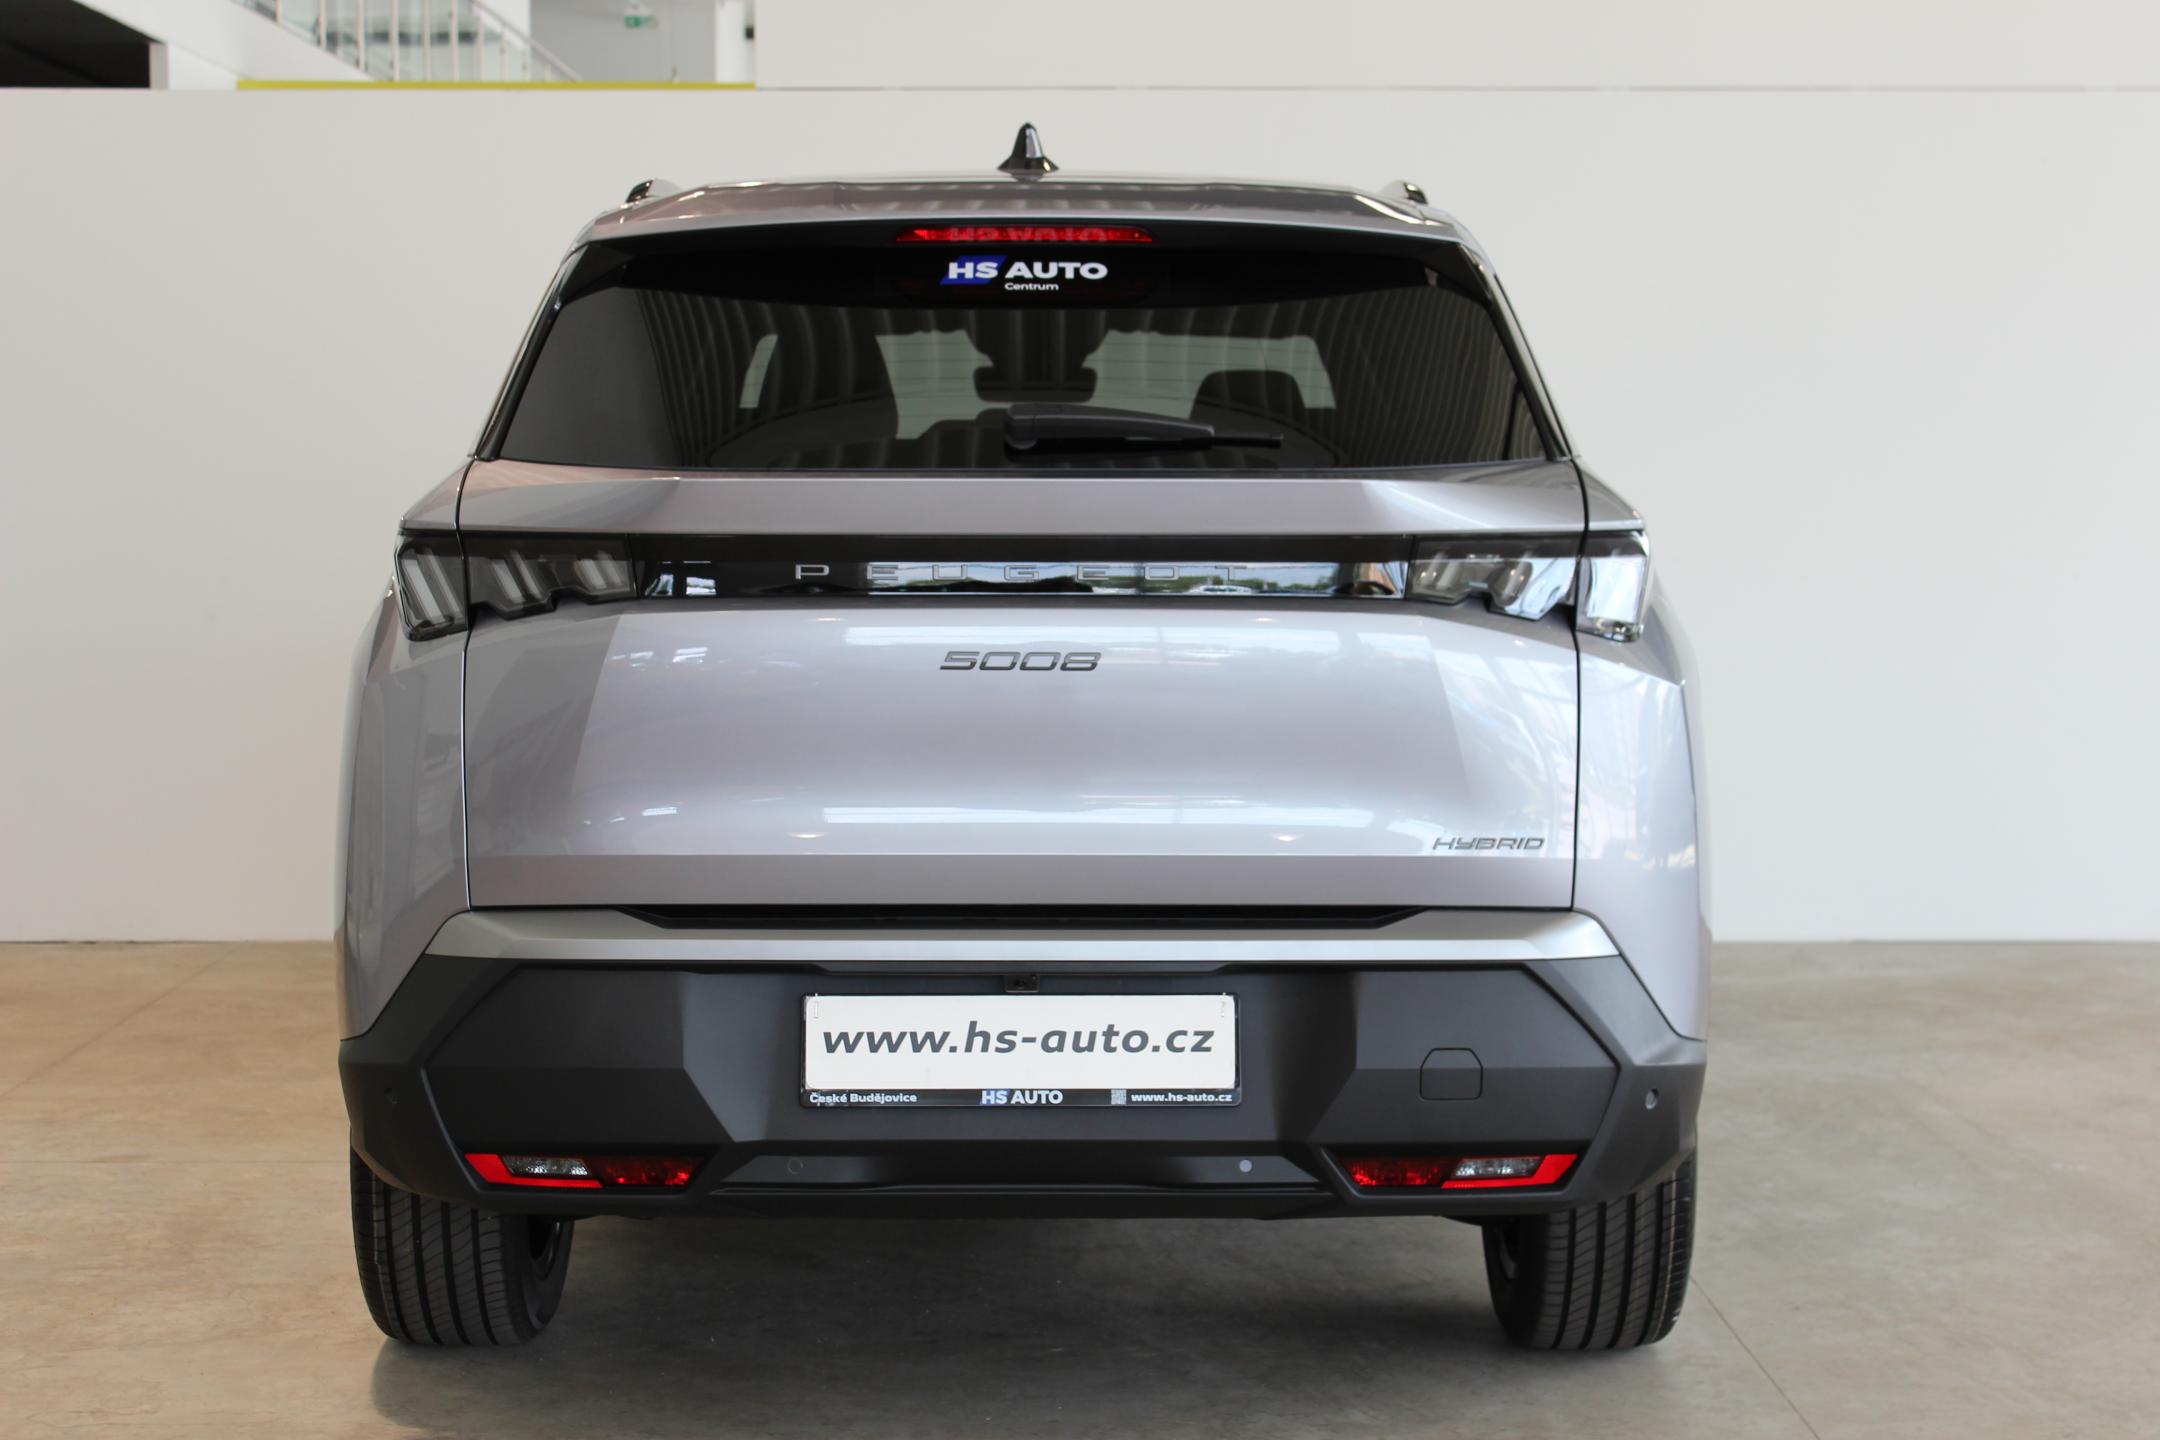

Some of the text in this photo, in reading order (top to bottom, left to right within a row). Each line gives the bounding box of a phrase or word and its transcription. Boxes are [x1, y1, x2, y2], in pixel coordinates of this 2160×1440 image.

[948, 261, 1108, 280] HS AUTO
[1004, 282, 1059, 291] Centrum
[795, 563, 1248, 581] PEUGEOT
[939, 651, 1102, 672] 5008
[1432, 837, 1545, 850] HYBRID
[823, 1021, 1215, 1054] www.hs-auto.cz
[809, 1092, 918, 1105] České Budějovice
[981, 1089, 1064, 1105] HS AUTO
[1130, 1092, 1233, 1103] www.hs-auto.cz
